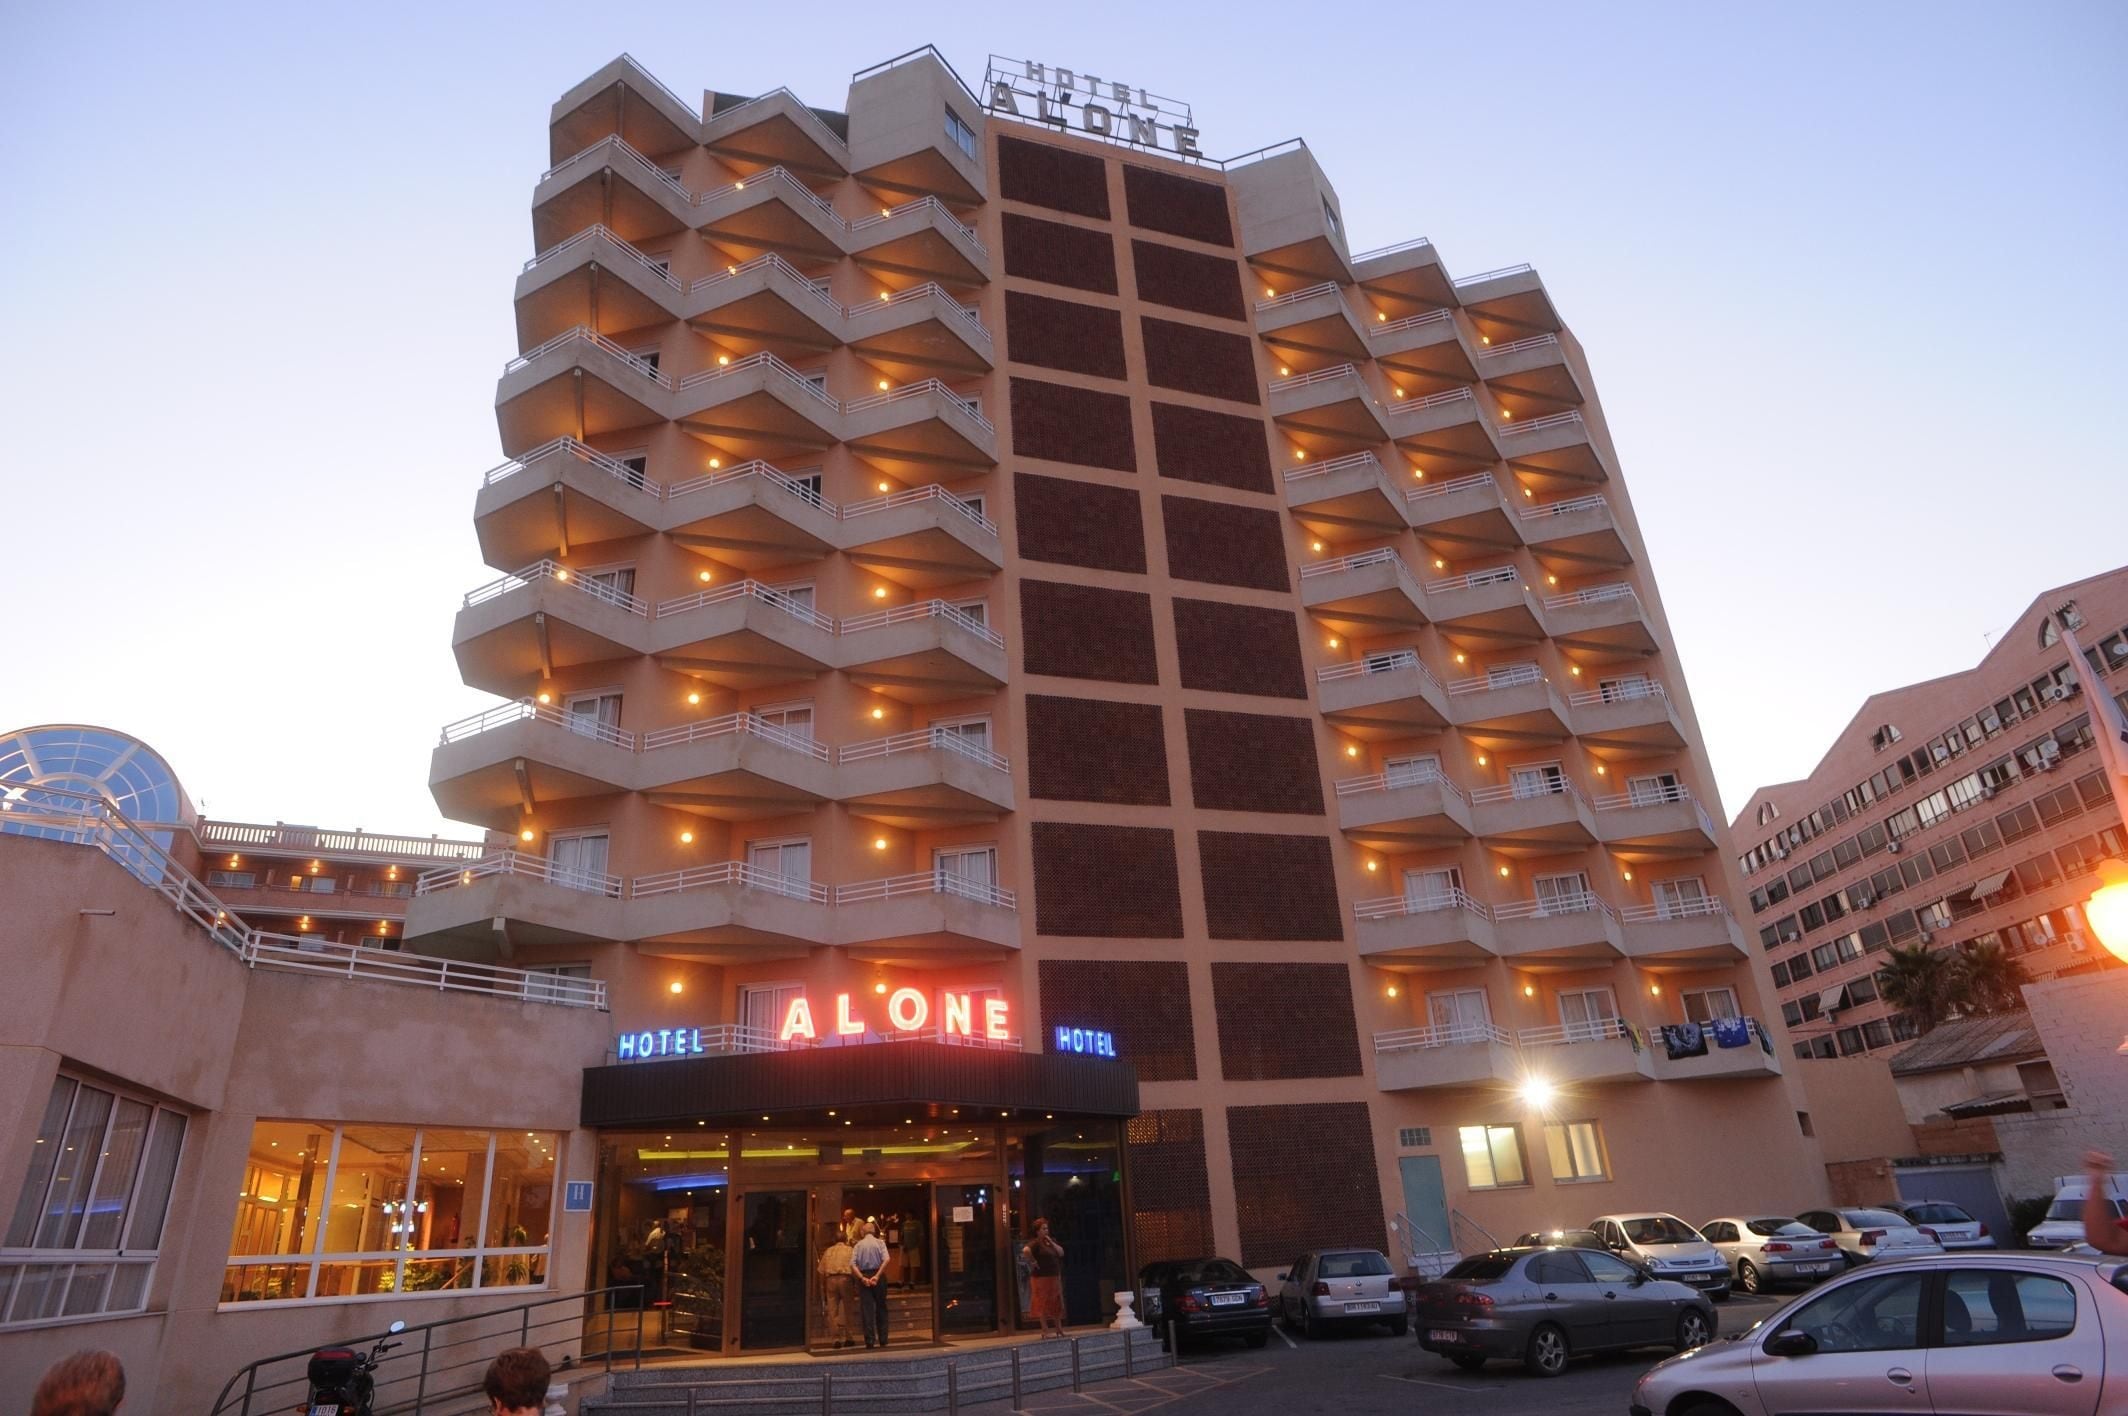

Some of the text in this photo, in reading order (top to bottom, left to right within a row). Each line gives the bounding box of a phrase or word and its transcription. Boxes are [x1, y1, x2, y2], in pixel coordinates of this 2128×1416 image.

[1026, 60, 1158, 111] HOTEL
[780, 987, 1009, 1041] ALONE
[619, 1027, 704, 1059] HOTEL
[1056, 1025, 1116, 1057] HOTEL
[573, 1184, 585, 1200] H
